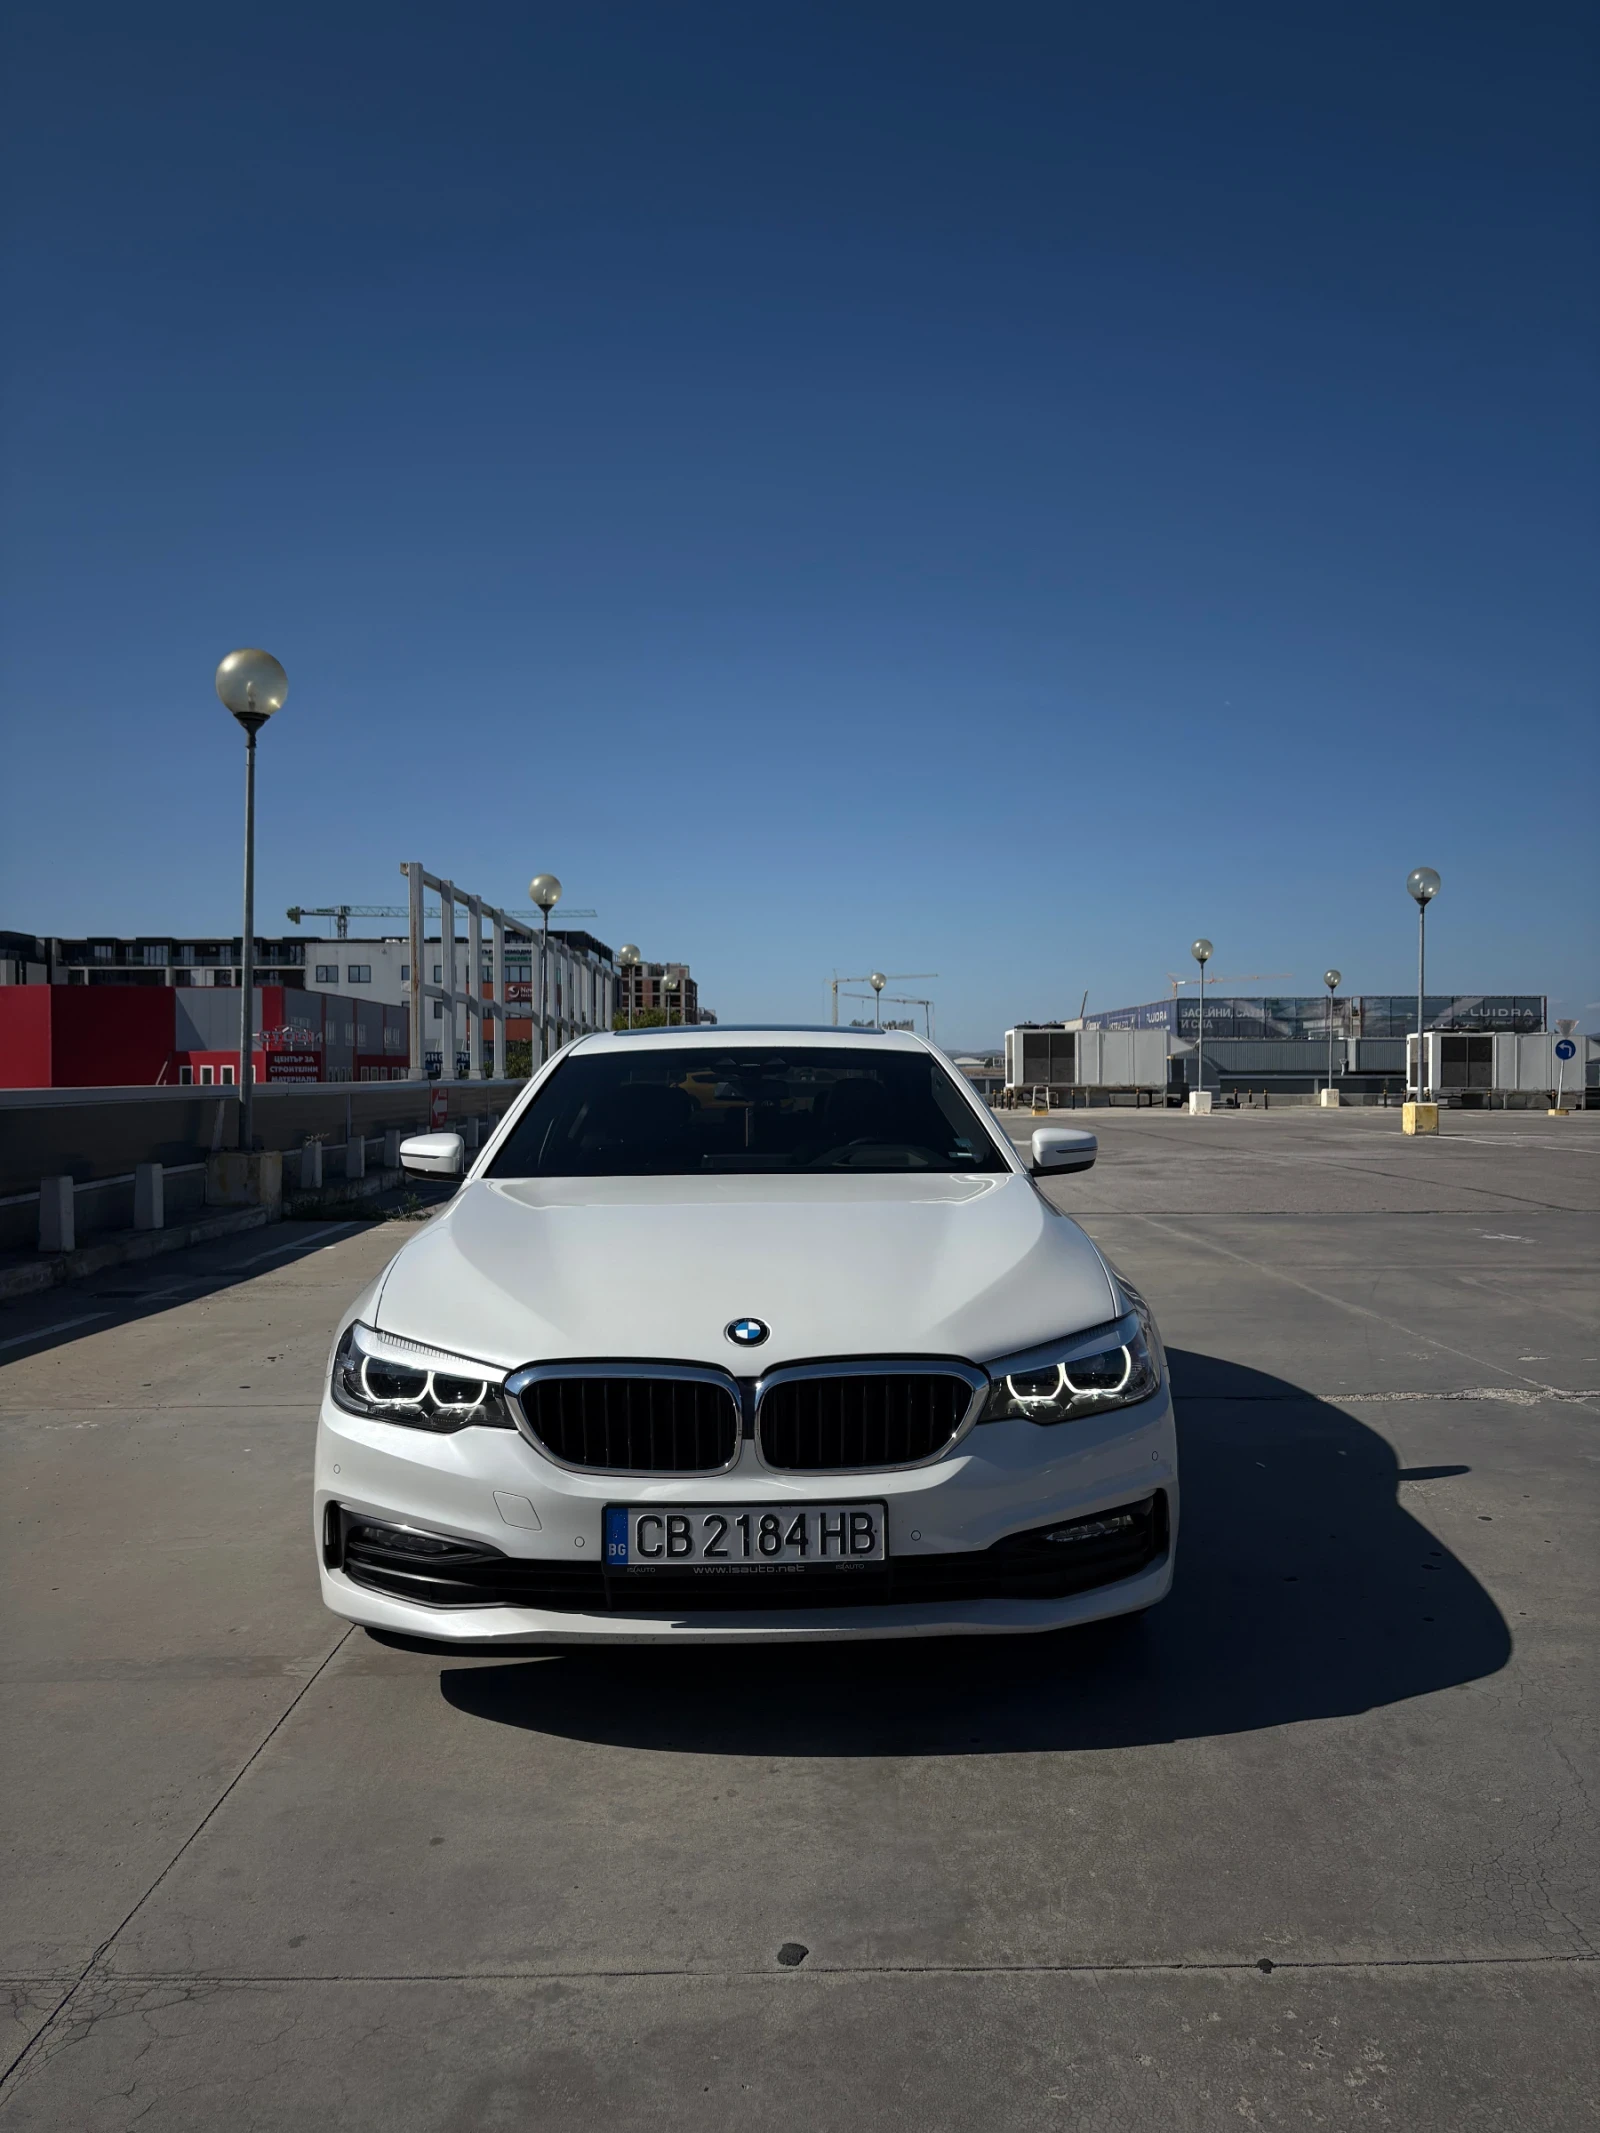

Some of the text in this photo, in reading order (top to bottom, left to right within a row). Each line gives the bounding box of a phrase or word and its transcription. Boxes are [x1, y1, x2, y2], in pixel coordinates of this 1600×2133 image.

[1459, 1008, 1534, 1017] FLUIDRA
[1181, 1019, 1189, 1029] И
[635, 1511, 876, 1558] CB 2184 HB
[608, 1543, 627, 1556] BG
[693, 1564, 806, 1574] www.isauto.net
